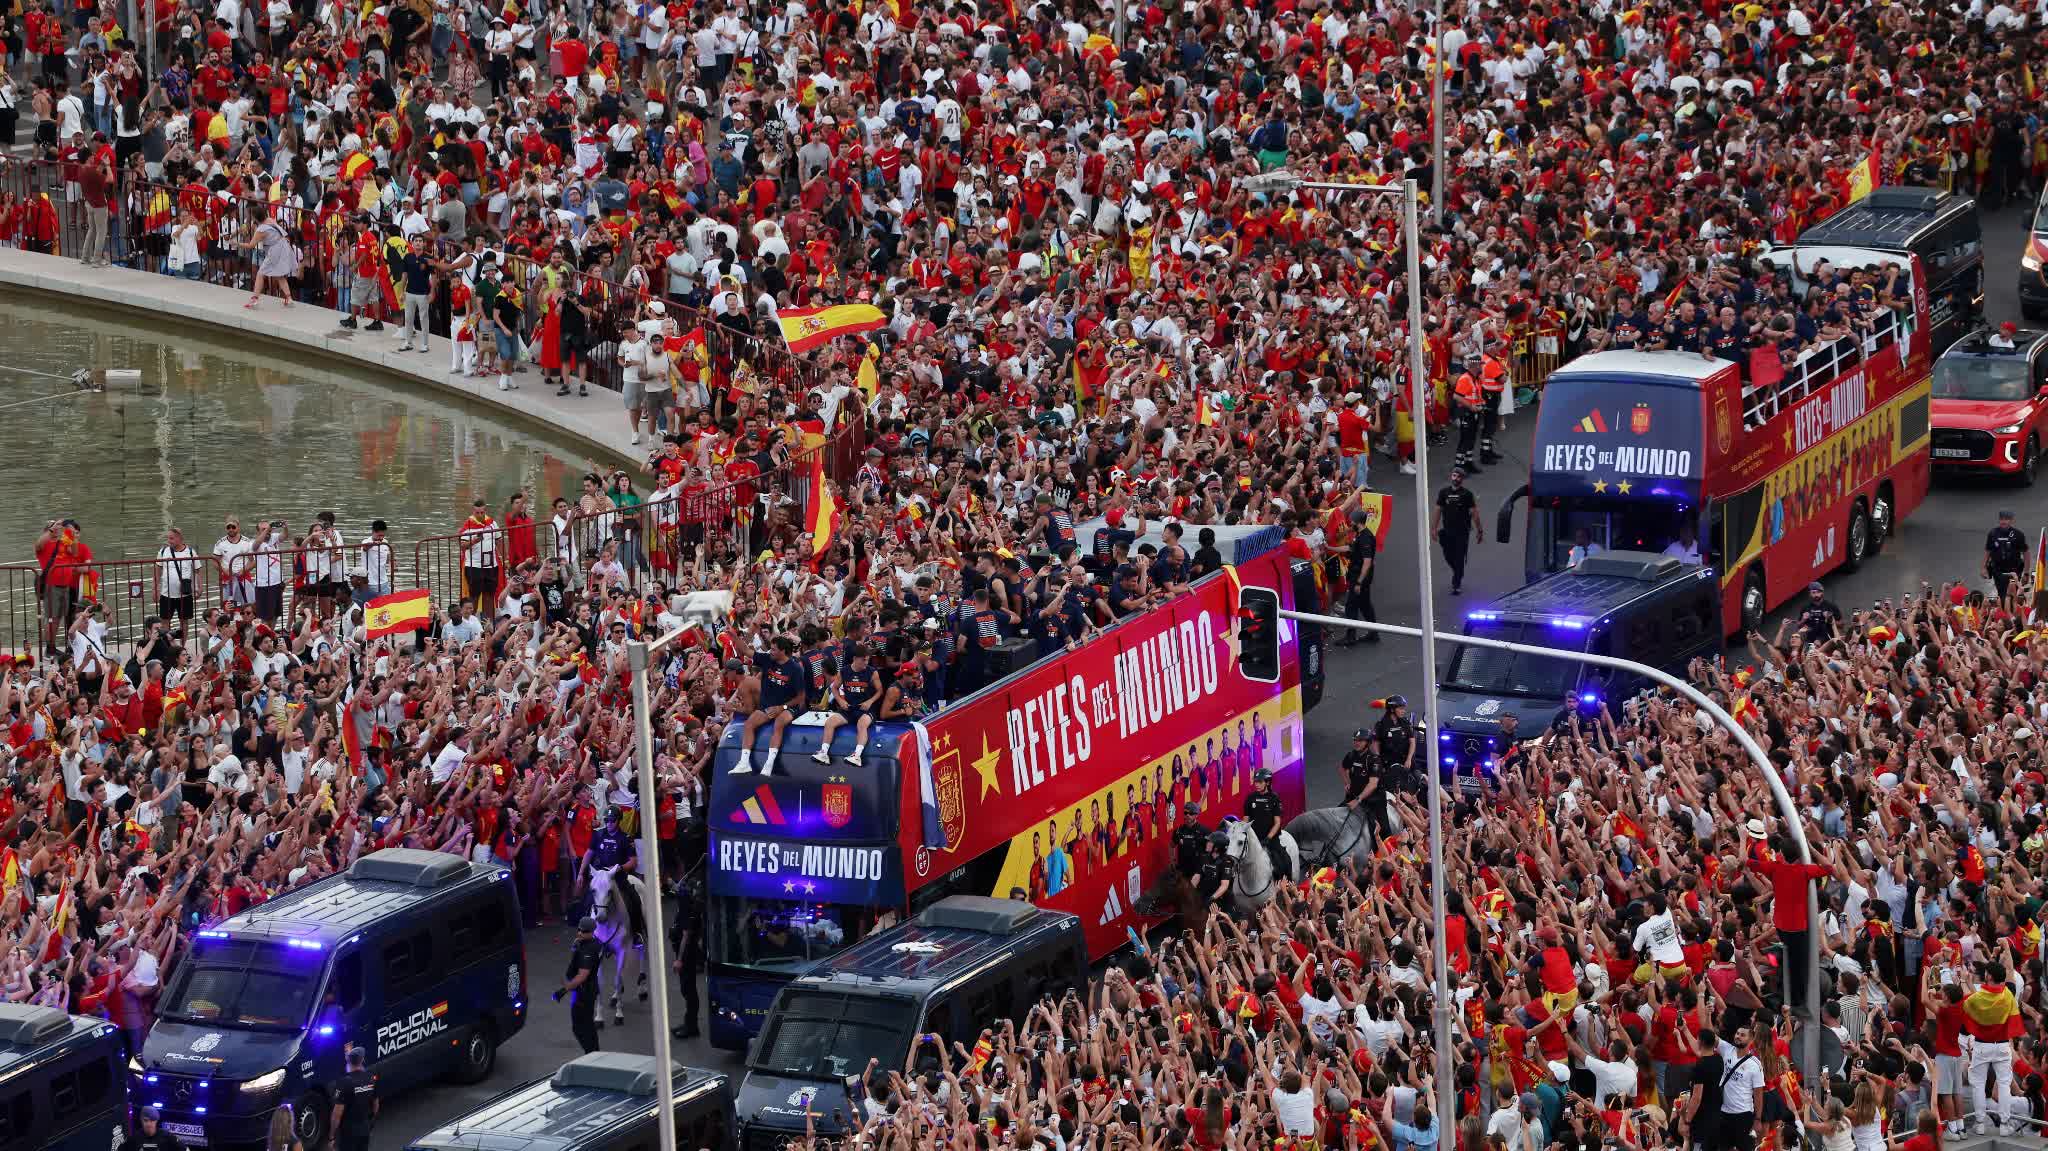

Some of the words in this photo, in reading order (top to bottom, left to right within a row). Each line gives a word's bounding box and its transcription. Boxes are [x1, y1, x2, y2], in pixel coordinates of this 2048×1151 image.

[908, 112, 917, 127] 6
[947, 107, 960, 125] 21
[1794, 395, 1823, 454] REYES
[1823, 402, 1831, 424] DEL
[1830, 370, 1866, 432] MUNDO
[1544, 444, 1596, 472] REYES
[1598, 451, 1614, 465] DEL
[1615, 446, 1691, 477] MUNDO
[1006, 674, 1091, 796] REYES
[1092, 680, 1116, 729] DEL
[1114, 610, 1218, 739] MUNDO
[720, 840, 779, 873] REYES
[783, 850, 800, 867] DEL
[801, 845, 882, 881] MUNDO
[377, 1007, 435, 1042] POLICIA
[377, 1019, 449, 1058] NACIONAL
[165, 1052, 209, 1062] POLICIA
[761, 1106, 809, 1116] POLICIA
